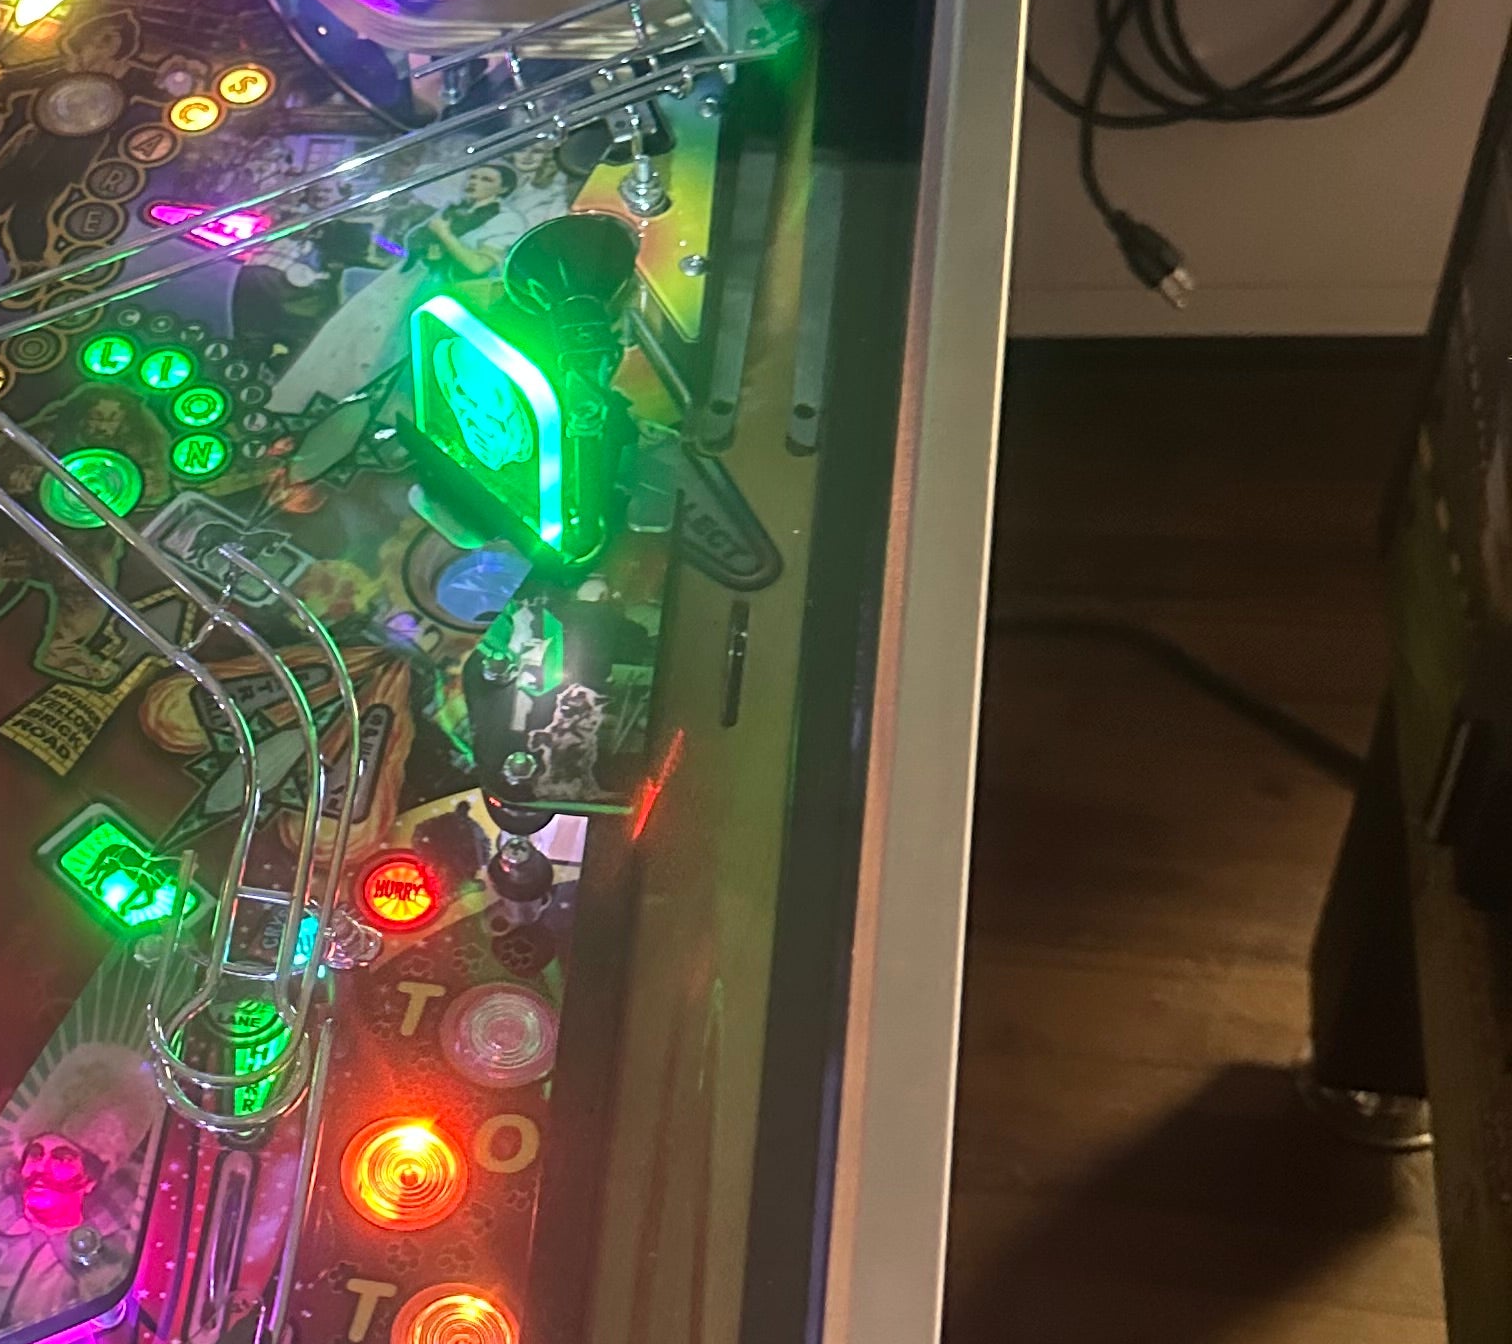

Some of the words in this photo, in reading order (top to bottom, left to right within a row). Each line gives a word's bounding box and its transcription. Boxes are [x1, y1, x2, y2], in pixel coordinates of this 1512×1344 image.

[26, 706, 83, 750] BRICK
[36, 695, 97, 738] YELLOW
[11, 719, 71, 760] ROAD
[375, 880, 422, 902] HURRY
